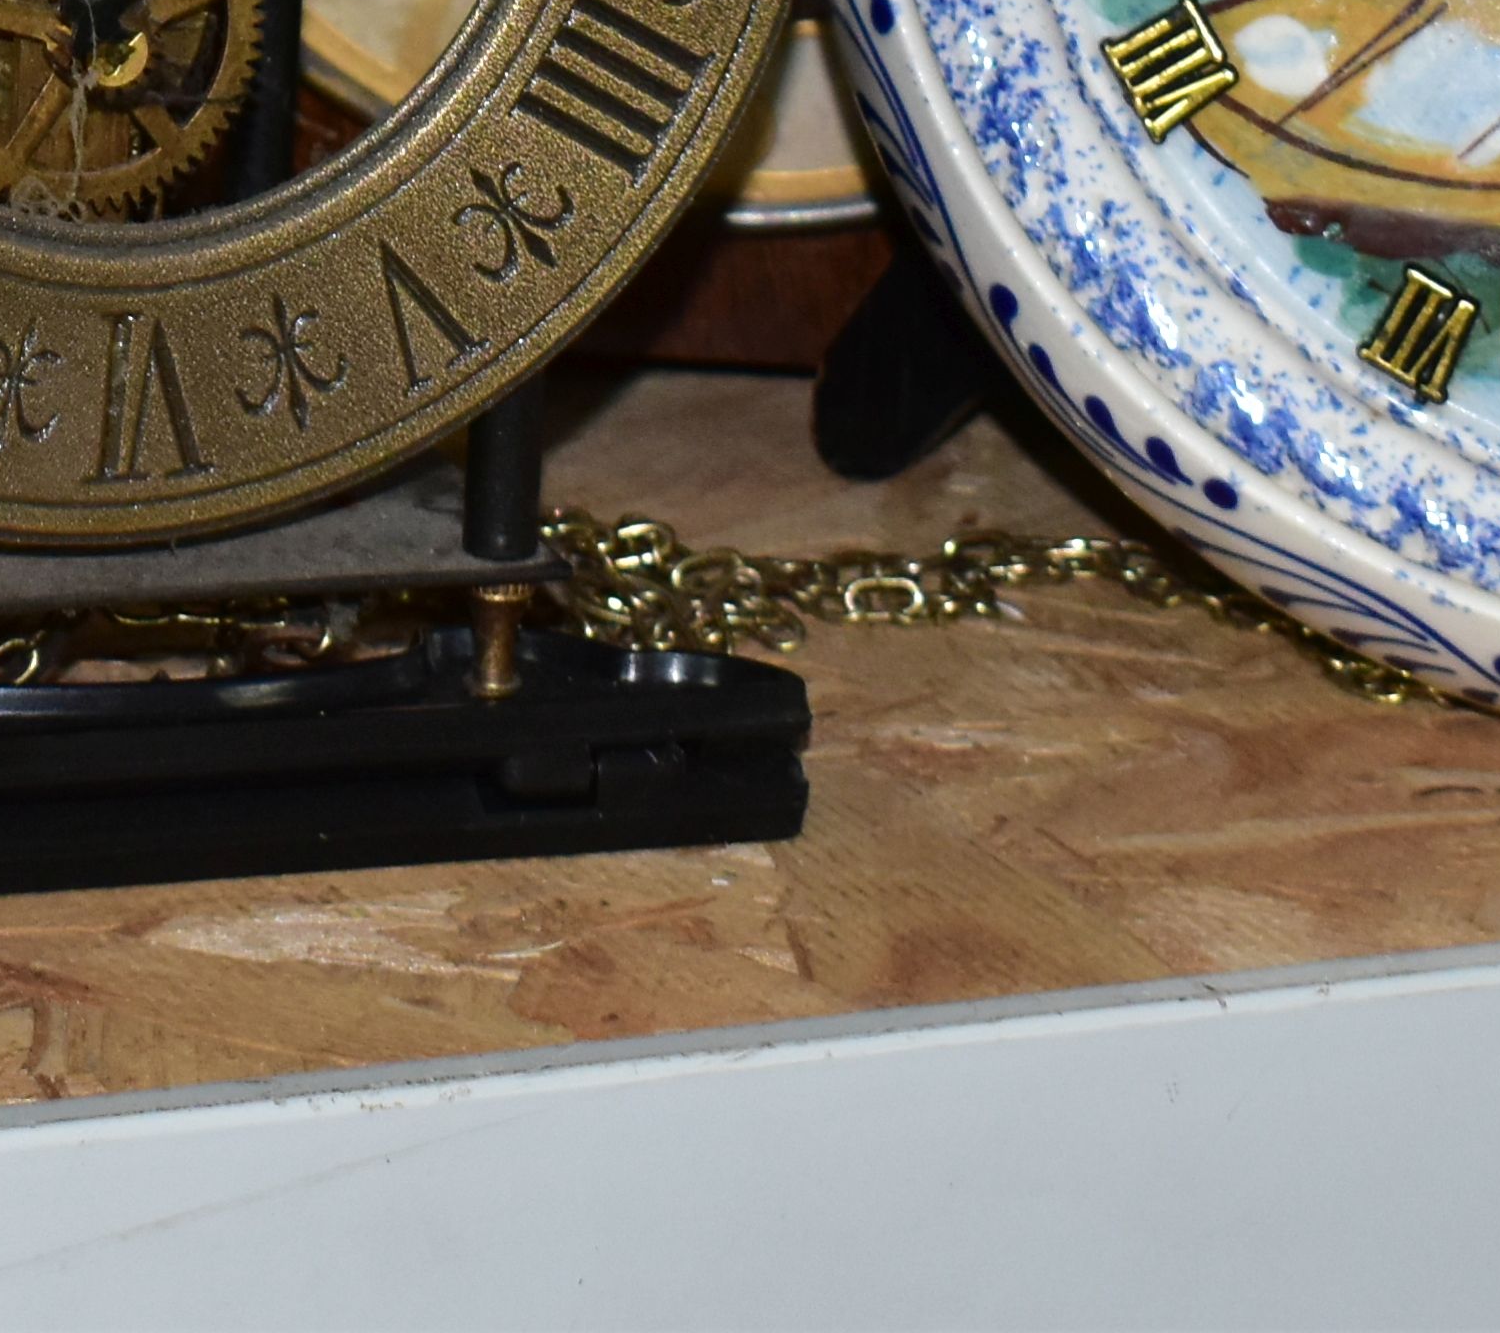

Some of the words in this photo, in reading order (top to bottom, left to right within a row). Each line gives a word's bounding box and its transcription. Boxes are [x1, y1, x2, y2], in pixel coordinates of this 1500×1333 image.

[84, 311, 215, 484] VI
[377, 239, 490, 399] V
[1357, 262, 1481, 404] VII
